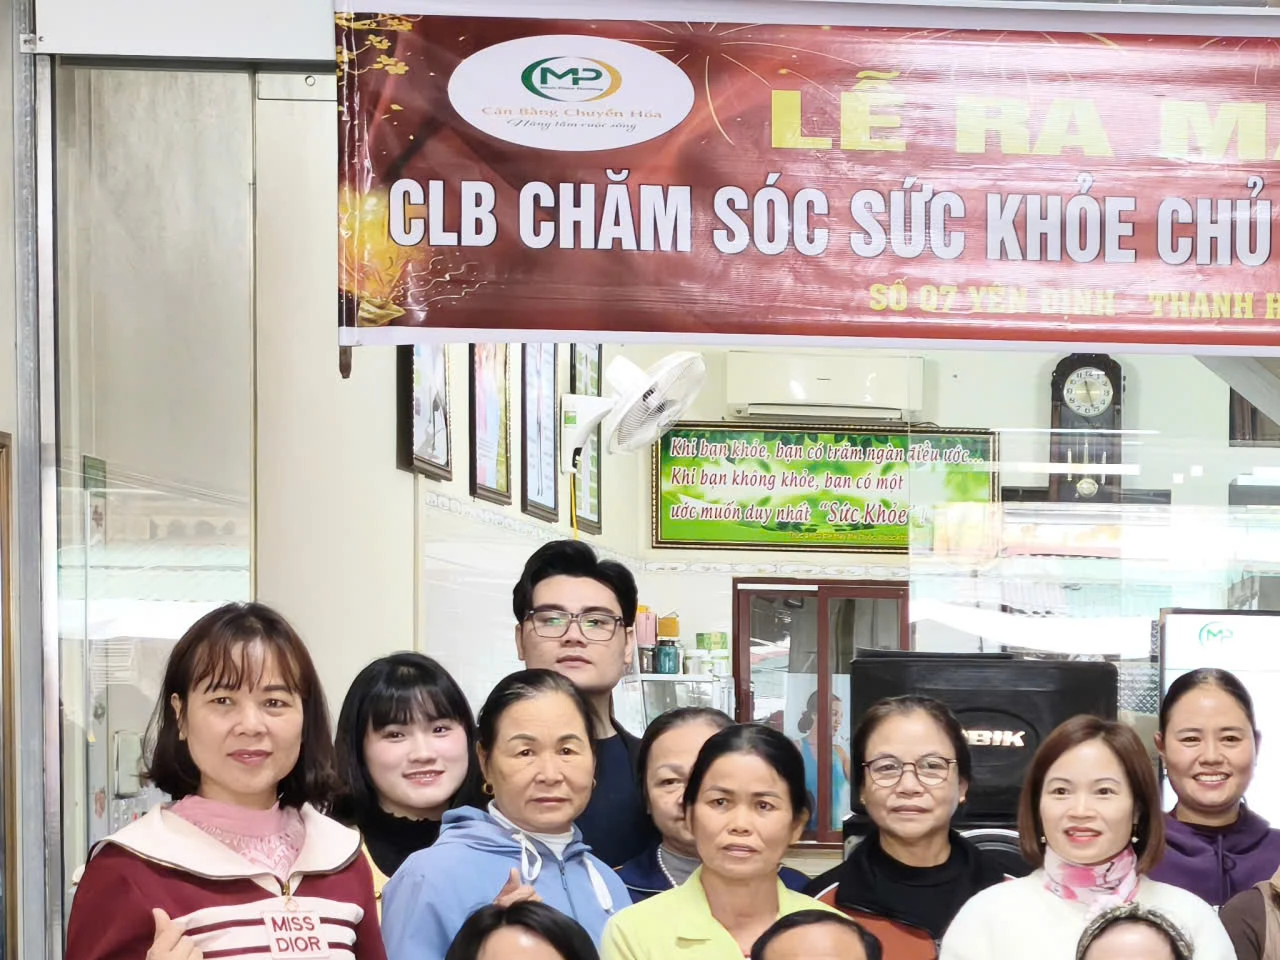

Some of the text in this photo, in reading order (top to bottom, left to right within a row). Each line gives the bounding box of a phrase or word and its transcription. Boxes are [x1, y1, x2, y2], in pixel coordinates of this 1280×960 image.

[770, 69, 909, 152] LỄ
[953, 98, 1112, 157] RA
[387, 177, 498, 249] CLB
[517, 168, 692, 254] CHĂM
[712, 172, 830, 259] SÓC
[849, 175, 967, 262] SỨC
[986, 173, 1137, 266] KHỎE
[1155, 177, 1272, 269] CHỦ
[869, 276, 908, 311] SỐ
[969, 282, 1027, 313] YÊN
[1148, 290, 1255, 320] THANH
[670, 437, 696, 457] Khi
[700, 438, 728, 461] bạn
[775, 440, 803, 463] bạn
[807, 441, 824, 461] có
[827, 442, 865, 462] trăm
[865, 443, 906, 465] ngàn
[670, 467, 904, 493] Khi bạn không khỏe, bạn có một
[670, 503, 697, 521] ước
[700, 499, 742, 522] muốn
[744, 503, 772, 526] duy
[775, 502, 811, 523] nhất
[271, 916, 315, 932] MISS
[274, 936, 322, 952] DIOR
